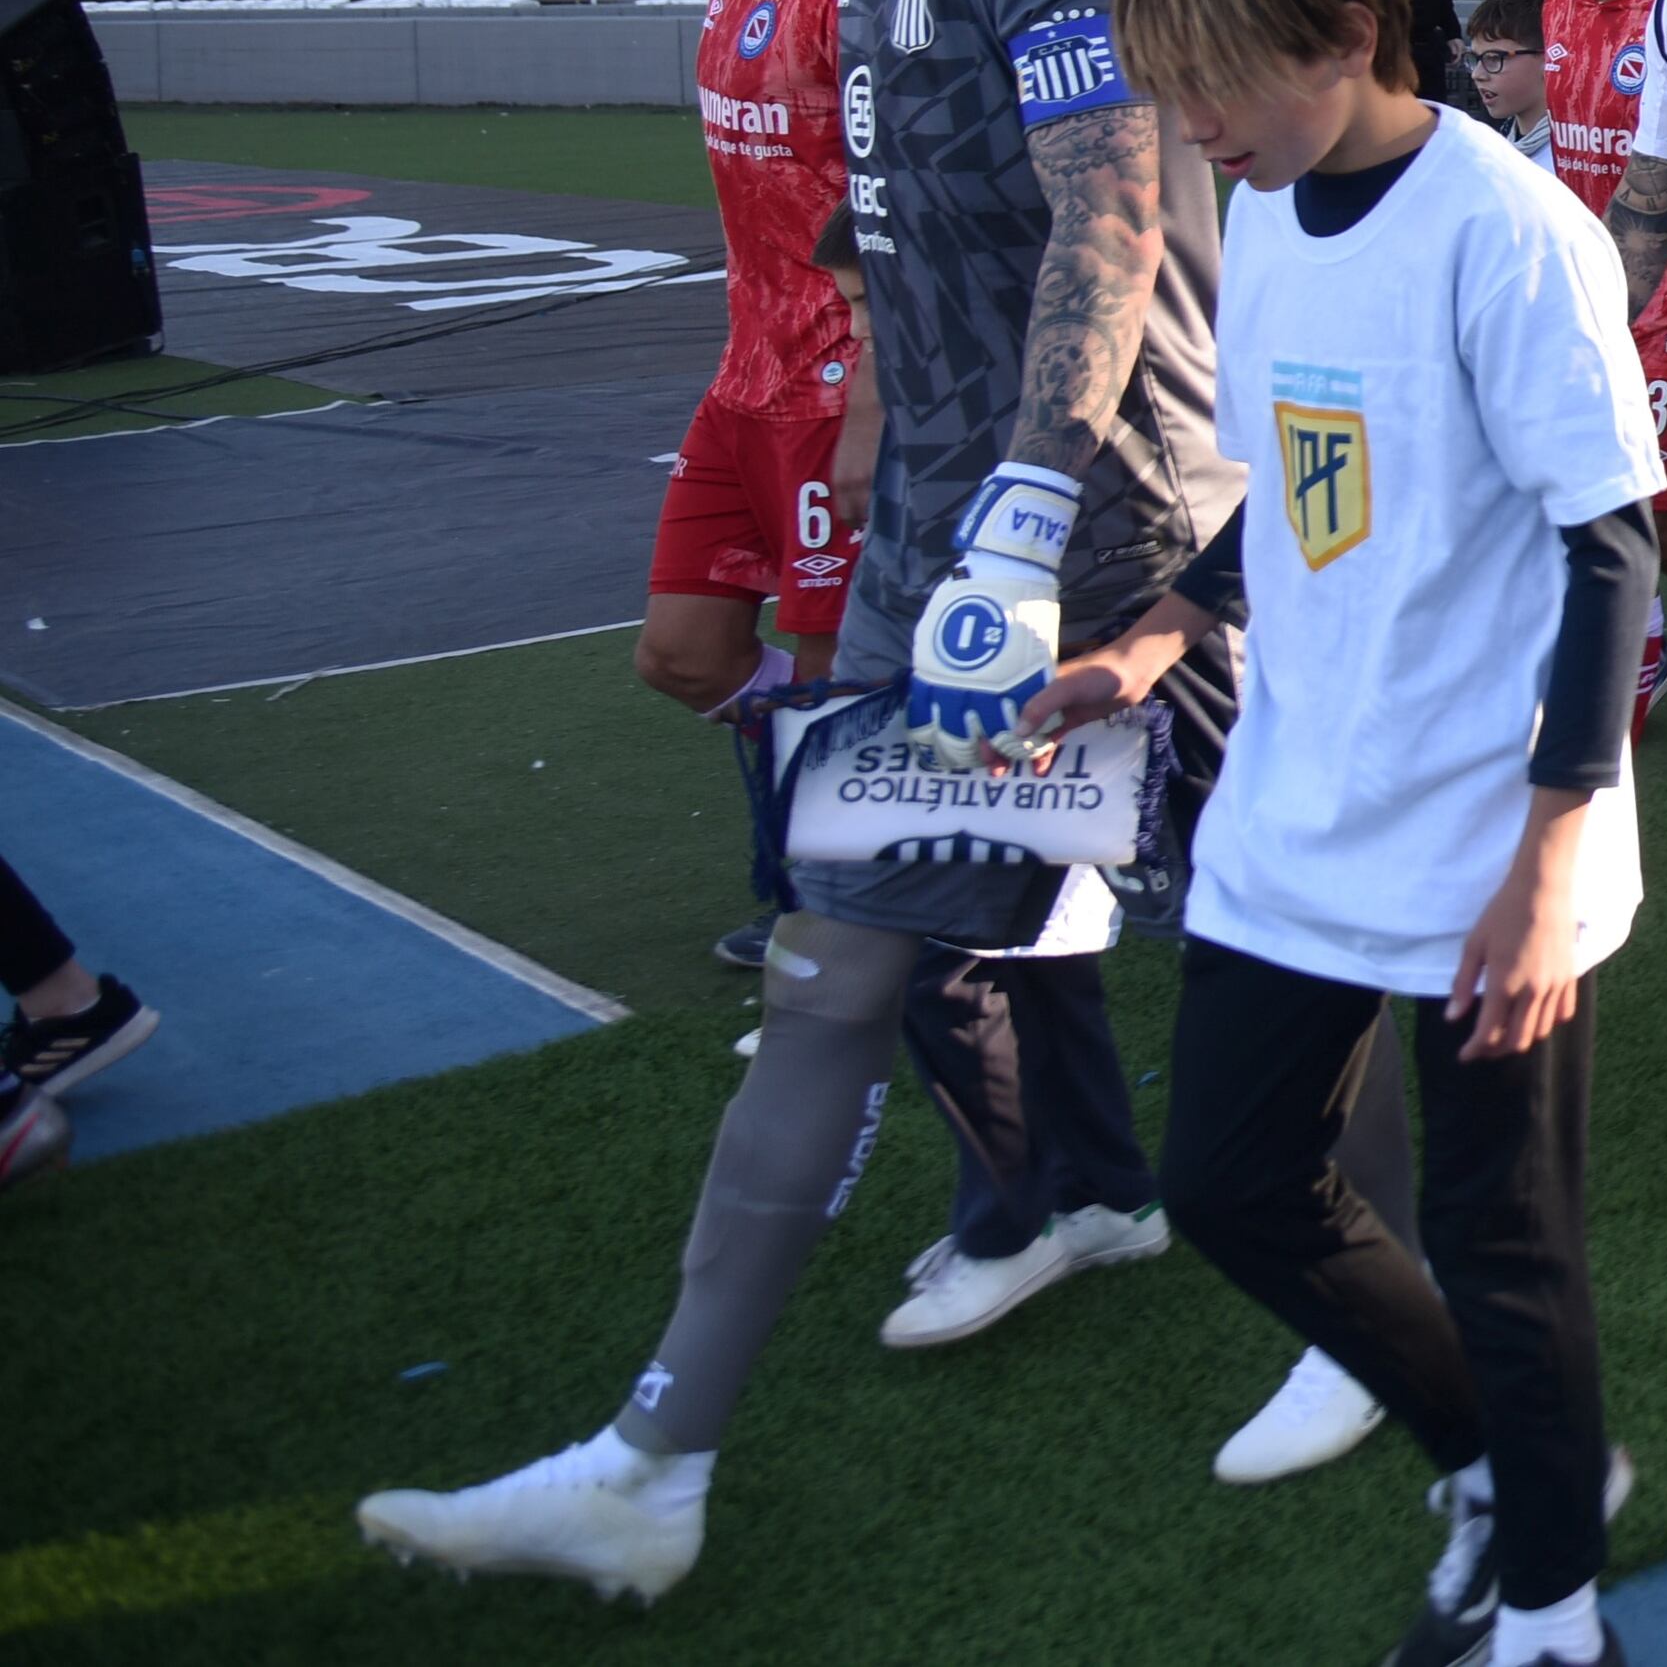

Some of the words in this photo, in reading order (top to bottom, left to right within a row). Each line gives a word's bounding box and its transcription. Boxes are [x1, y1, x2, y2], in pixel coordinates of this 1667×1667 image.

[754, 143, 794, 161] gusta
[798, 481, 831, 548] 6
[838, 775, 1009, 812] ATLÉTICO
[1015, 781, 1104, 810] CLUB
